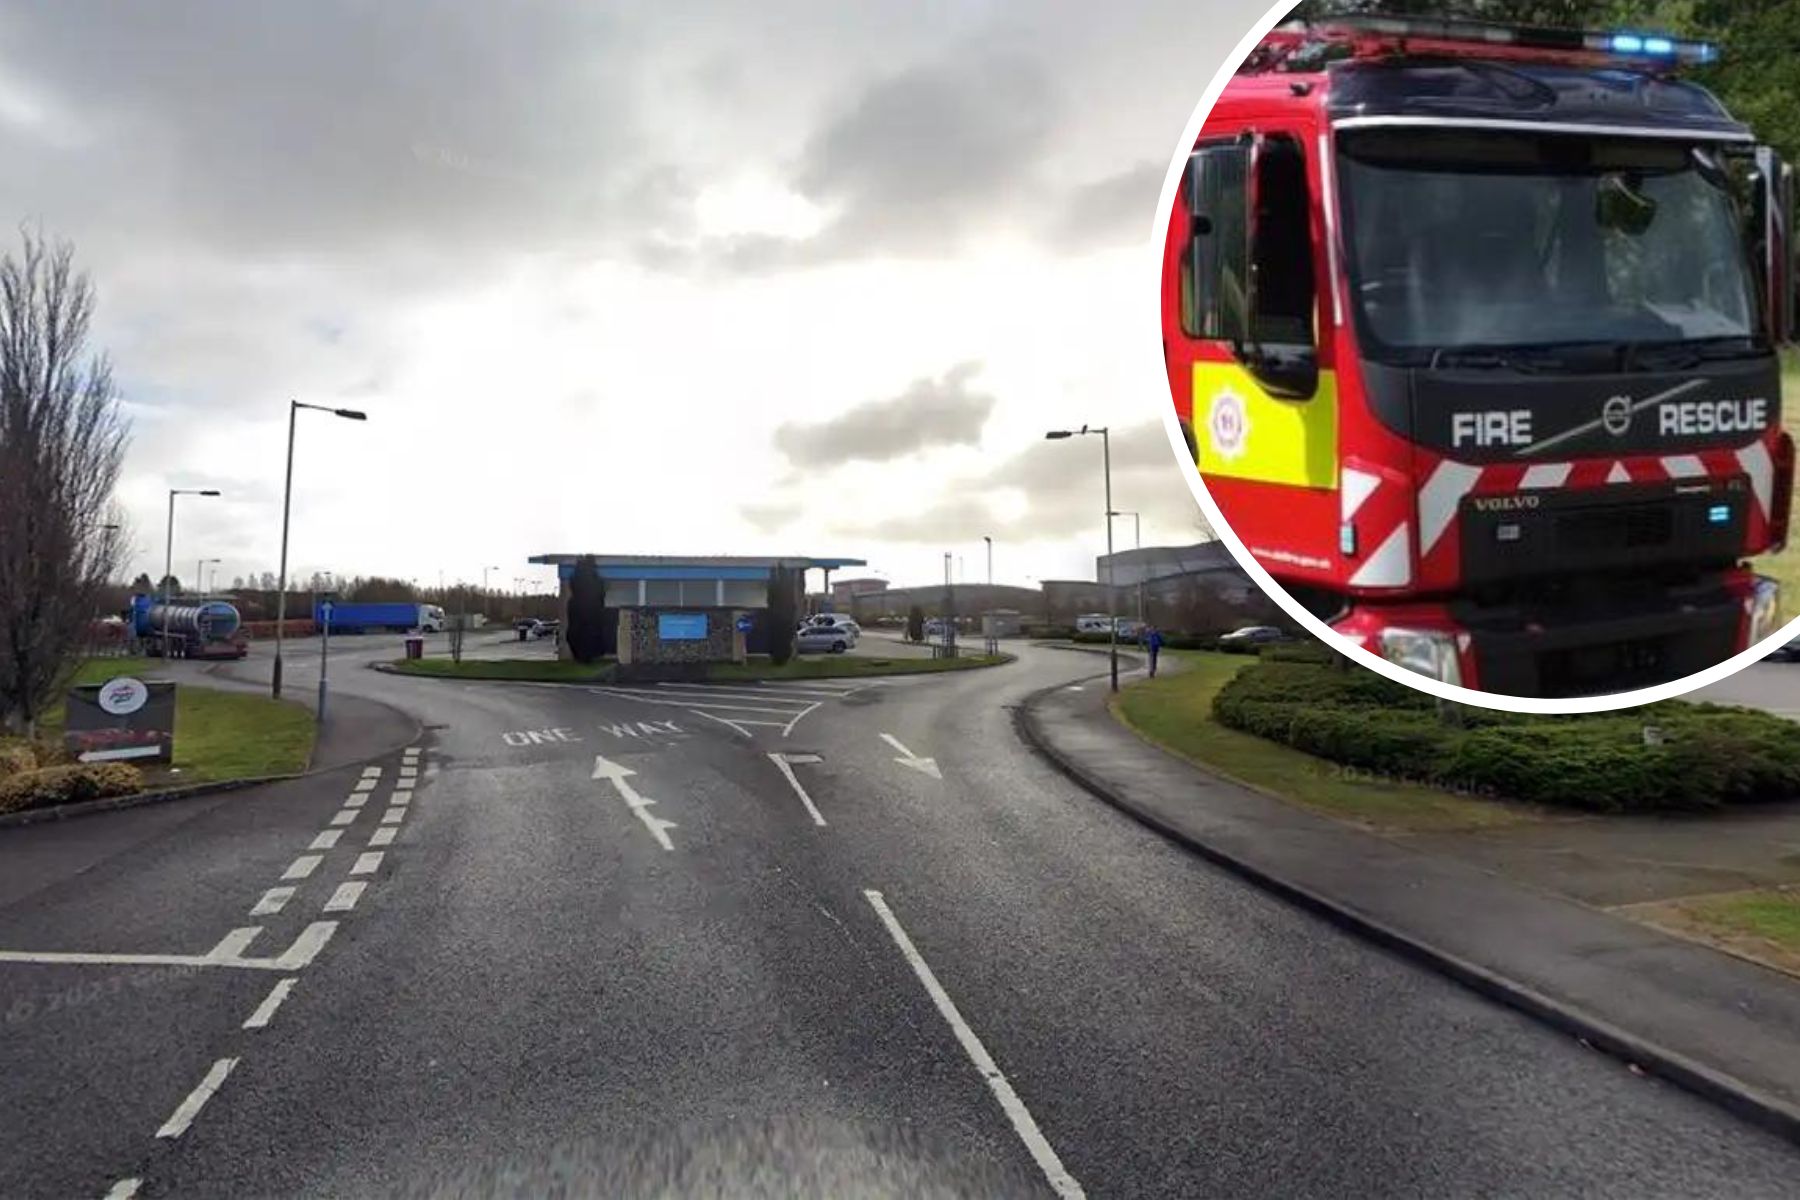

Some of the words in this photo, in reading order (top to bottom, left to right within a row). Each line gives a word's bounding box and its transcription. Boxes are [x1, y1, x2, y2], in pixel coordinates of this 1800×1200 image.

[1451, 410, 1533, 447] FIRE
[1659, 399, 1767, 436] RESCUE
[1475, 495, 1540, 511] VOLVO
[502, 727, 584, 746] ONE
